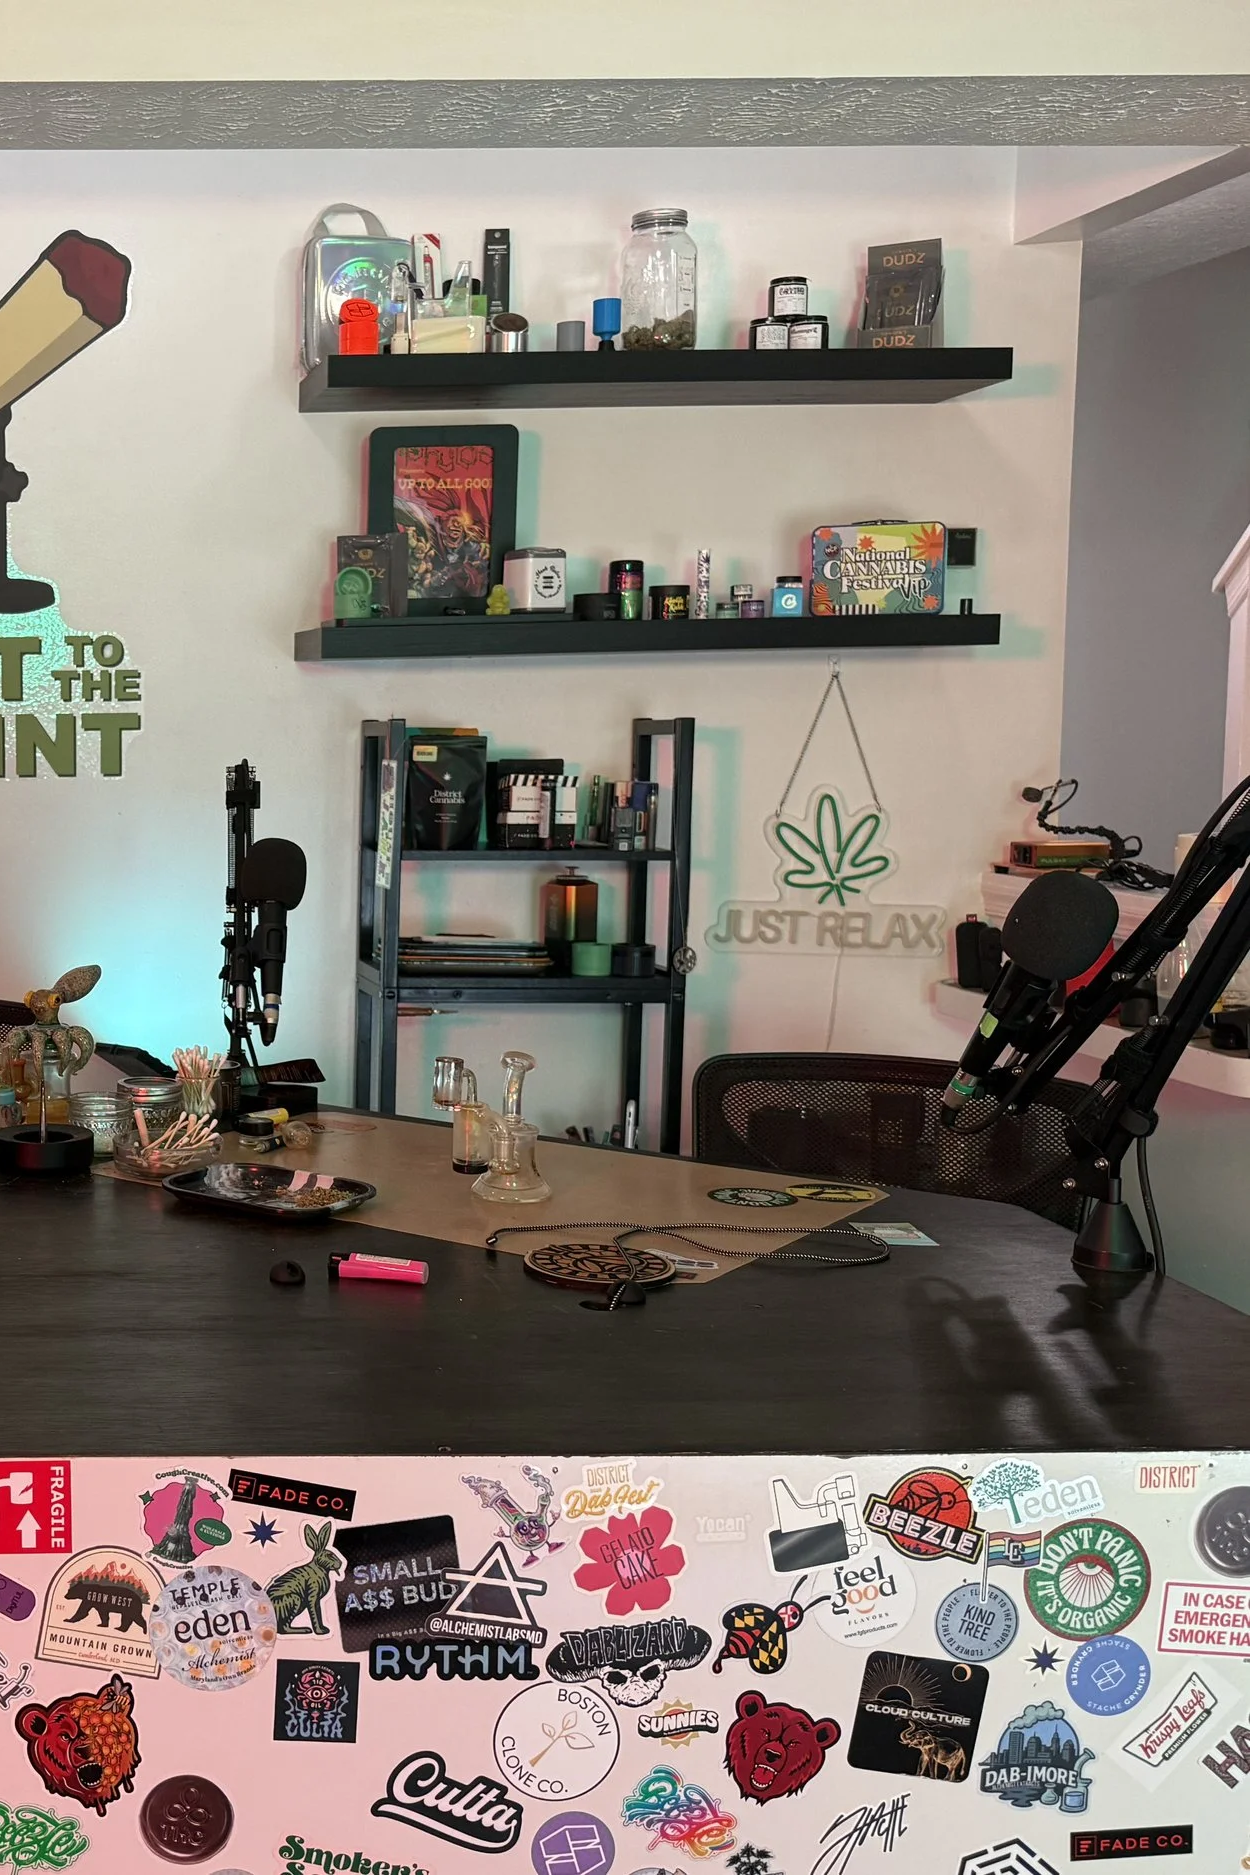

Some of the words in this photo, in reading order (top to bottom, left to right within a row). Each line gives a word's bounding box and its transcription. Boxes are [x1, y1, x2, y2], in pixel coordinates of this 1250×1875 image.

[883, 253, 926, 267] DUDZ
[872, 335, 916, 349] DUDZ
[437, 478, 463, 490] ALL
[464, 477, 493, 489] GOO
[841, 547, 911, 563] National
[65, 634, 125, 668] TO
[51, 669, 141, 702] THE
[430, 795, 465, 805] Cannabis
[434, 789, 463, 798] District
[714, 908, 812, 944] JUST
[815, 911, 940, 949] RELAX
[155, 1469, 230, 1498] CoughCreative.com
[586, 1464, 630, 1487] DISTRICT
[1139, 1465, 1198, 1489] DISTRICT
[50, 1465, 66, 1548] FRAGILE
[258, 1484, 308, 1505] FADE
[316, 1495, 349, 1512] CO.
[1023, 1478, 1099, 1518] eden
[867, 1502, 979, 1557] BEEZLE
[600, 1526, 655, 1564] GELATO
[1003, 1537, 1026, 1563] LC
[1040, 1527, 1094, 1575] DON'T
[1094, 1529, 1142, 1588] PANIC
[353, 1556, 442, 1585] SMALL
[614, 1550, 664, 1590] CAKE
[833, 1555, 887, 1590] feel
[87, 1591, 110, 1605] GROW
[111, 1594, 133, 1607] WEST
[169, 1577, 241, 1605] TEMPLE
[344, 1586, 396, 1613] A$$
[831, 1574, 899, 1616] good
[1036, 1580, 1062, 1615] IT'S
[1183, 1592, 1201, 1607] IN
[1202, 1592, 1246, 1610] CASE
[847, 1611, 890, 1626] FLAVORS
[963, 1604, 997, 1627] KIND
[1003, 1609, 1013, 1622] THE
[1057, 1590, 1133, 1630] ORGANIC
[1173, 1609, 1250, 1629] EMERGEN
[174, 1608, 252, 1644] eden
[429, 1617, 543, 1646] @ALCHEMISTLABSMD
[958, 1618, 991, 1642] TREE
[994, 1624, 1012, 1649] PEOPLE
[1167, 1628, 1229, 1646] SMOKE
[49, 1633, 109, 1652] MOUNTAIN
[113, 1643, 153, 1659] GROWN
[566, 1617, 688, 1667] DABLIZARD
[181, 1647, 256, 1672] Alchemist
[375, 1644, 526, 1675] RYTHM
[557, 1688, 612, 1737] BOSTON
[637, 1710, 719, 1734] SUNNIES
[865, 1703, 909, 1718] CLOUD
[911, 1709, 972, 1727] CULTURE
[1138, 1710, 1183, 1760] Krispy
[1173, 1688, 1206, 1722] Leafs
[284, 1718, 343, 1738] CULTA
[1164, 1732, 1189, 1759] PREMIUM
[1186, 1711, 1209, 1737] FLOWER
[500, 1735, 538, 1789] CLONE
[537, 1779, 569, 1794] CO.
[985, 1767, 1079, 1788] DAB-IMORE
[393, 1757, 519, 1833] Culta
[1100, 1835, 1150, 1852] FADE
[1156, 1834, 1189, 1848] CO.
